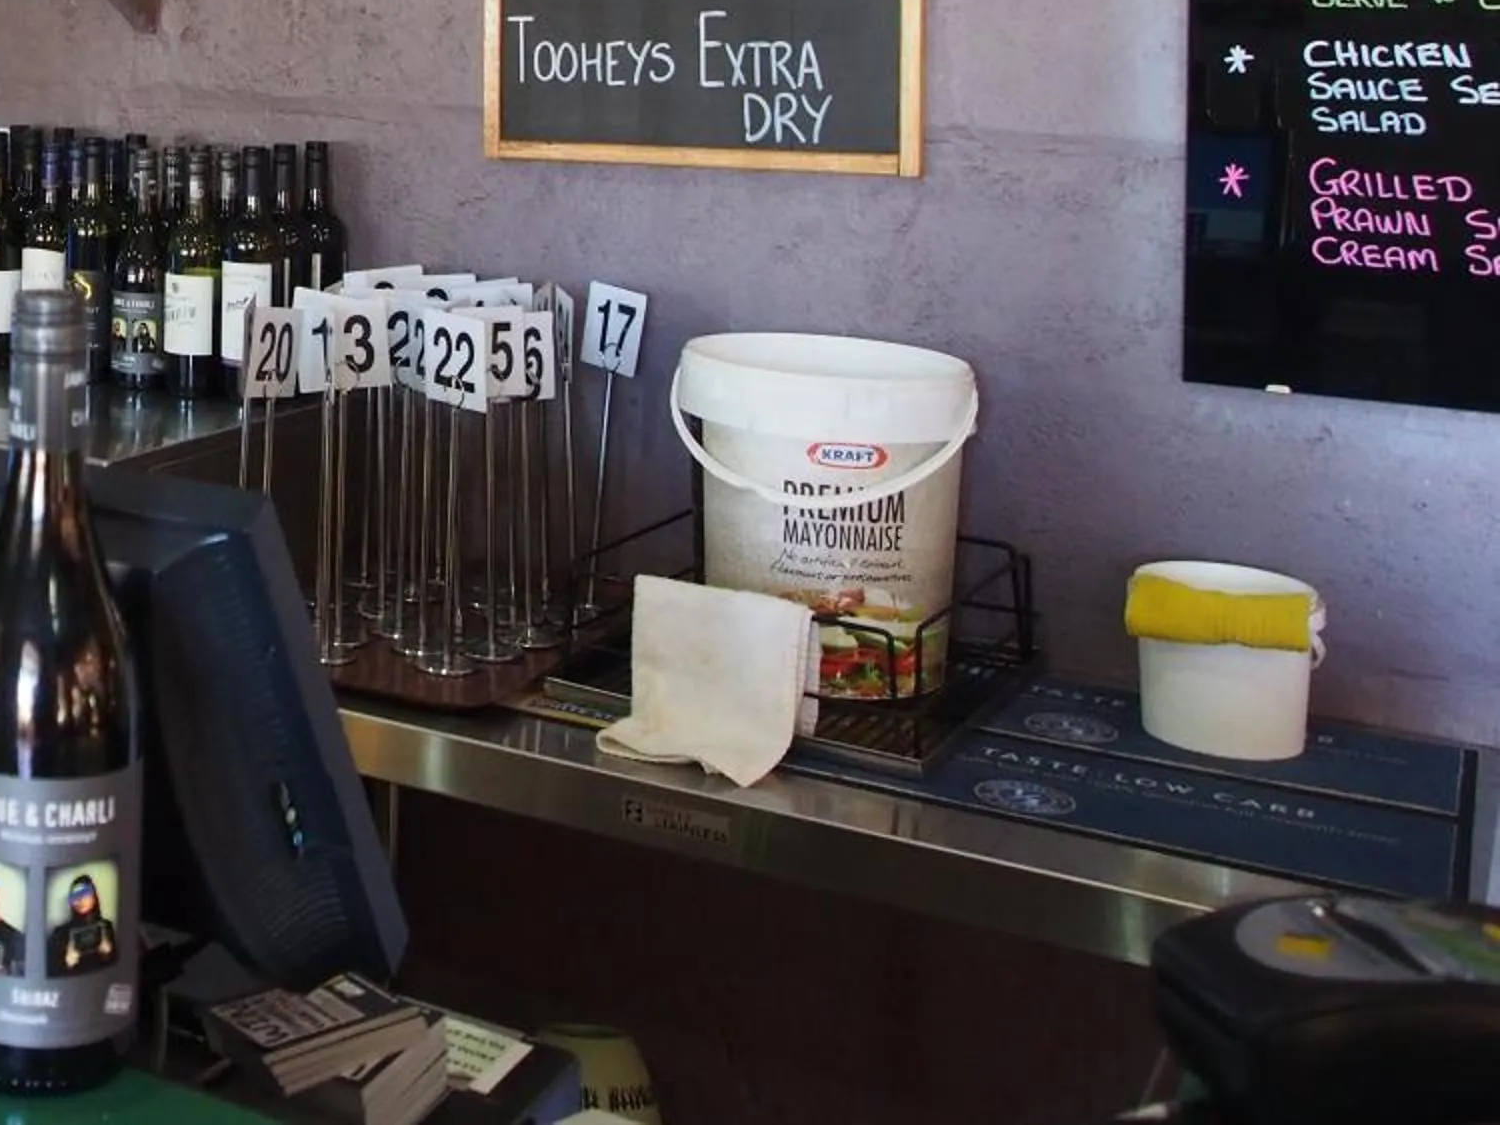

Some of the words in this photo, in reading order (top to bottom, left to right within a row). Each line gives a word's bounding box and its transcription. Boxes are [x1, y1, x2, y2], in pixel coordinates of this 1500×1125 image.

[506, 15, 675, 87] TOOHEYS
[699, 10, 824, 91] EXTRA
[1303, 40, 1472, 68] CHICKEN
[1307, 72, 1428, 101] SAUCE
[743, 93, 833, 145] DRY
[1311, 106, 1427, 135] SALAD
[1309, 157, 1473, 202] GRILLED
[1310, 197, 1431, 237] PRAWN
[1312, 236, 1440, 272] CREAM
[344, 313, 375, 373] 3
[598, 299, 636, 358] 17
[255, 322, 293, 382] 20
[434, 327, 475, 393] 22
[491, 322, 513, 381] 5
[821, 448, 875, 463] KRAFT
[783, 518, 902, 551] MAYONNAISE
[981, 745, 1088, 776] TASTE
[1115, 772, 1195, 795] LOW
[1212, 791, 1315, 820] CARB
[45, 796, 116, 828] CHARLI
